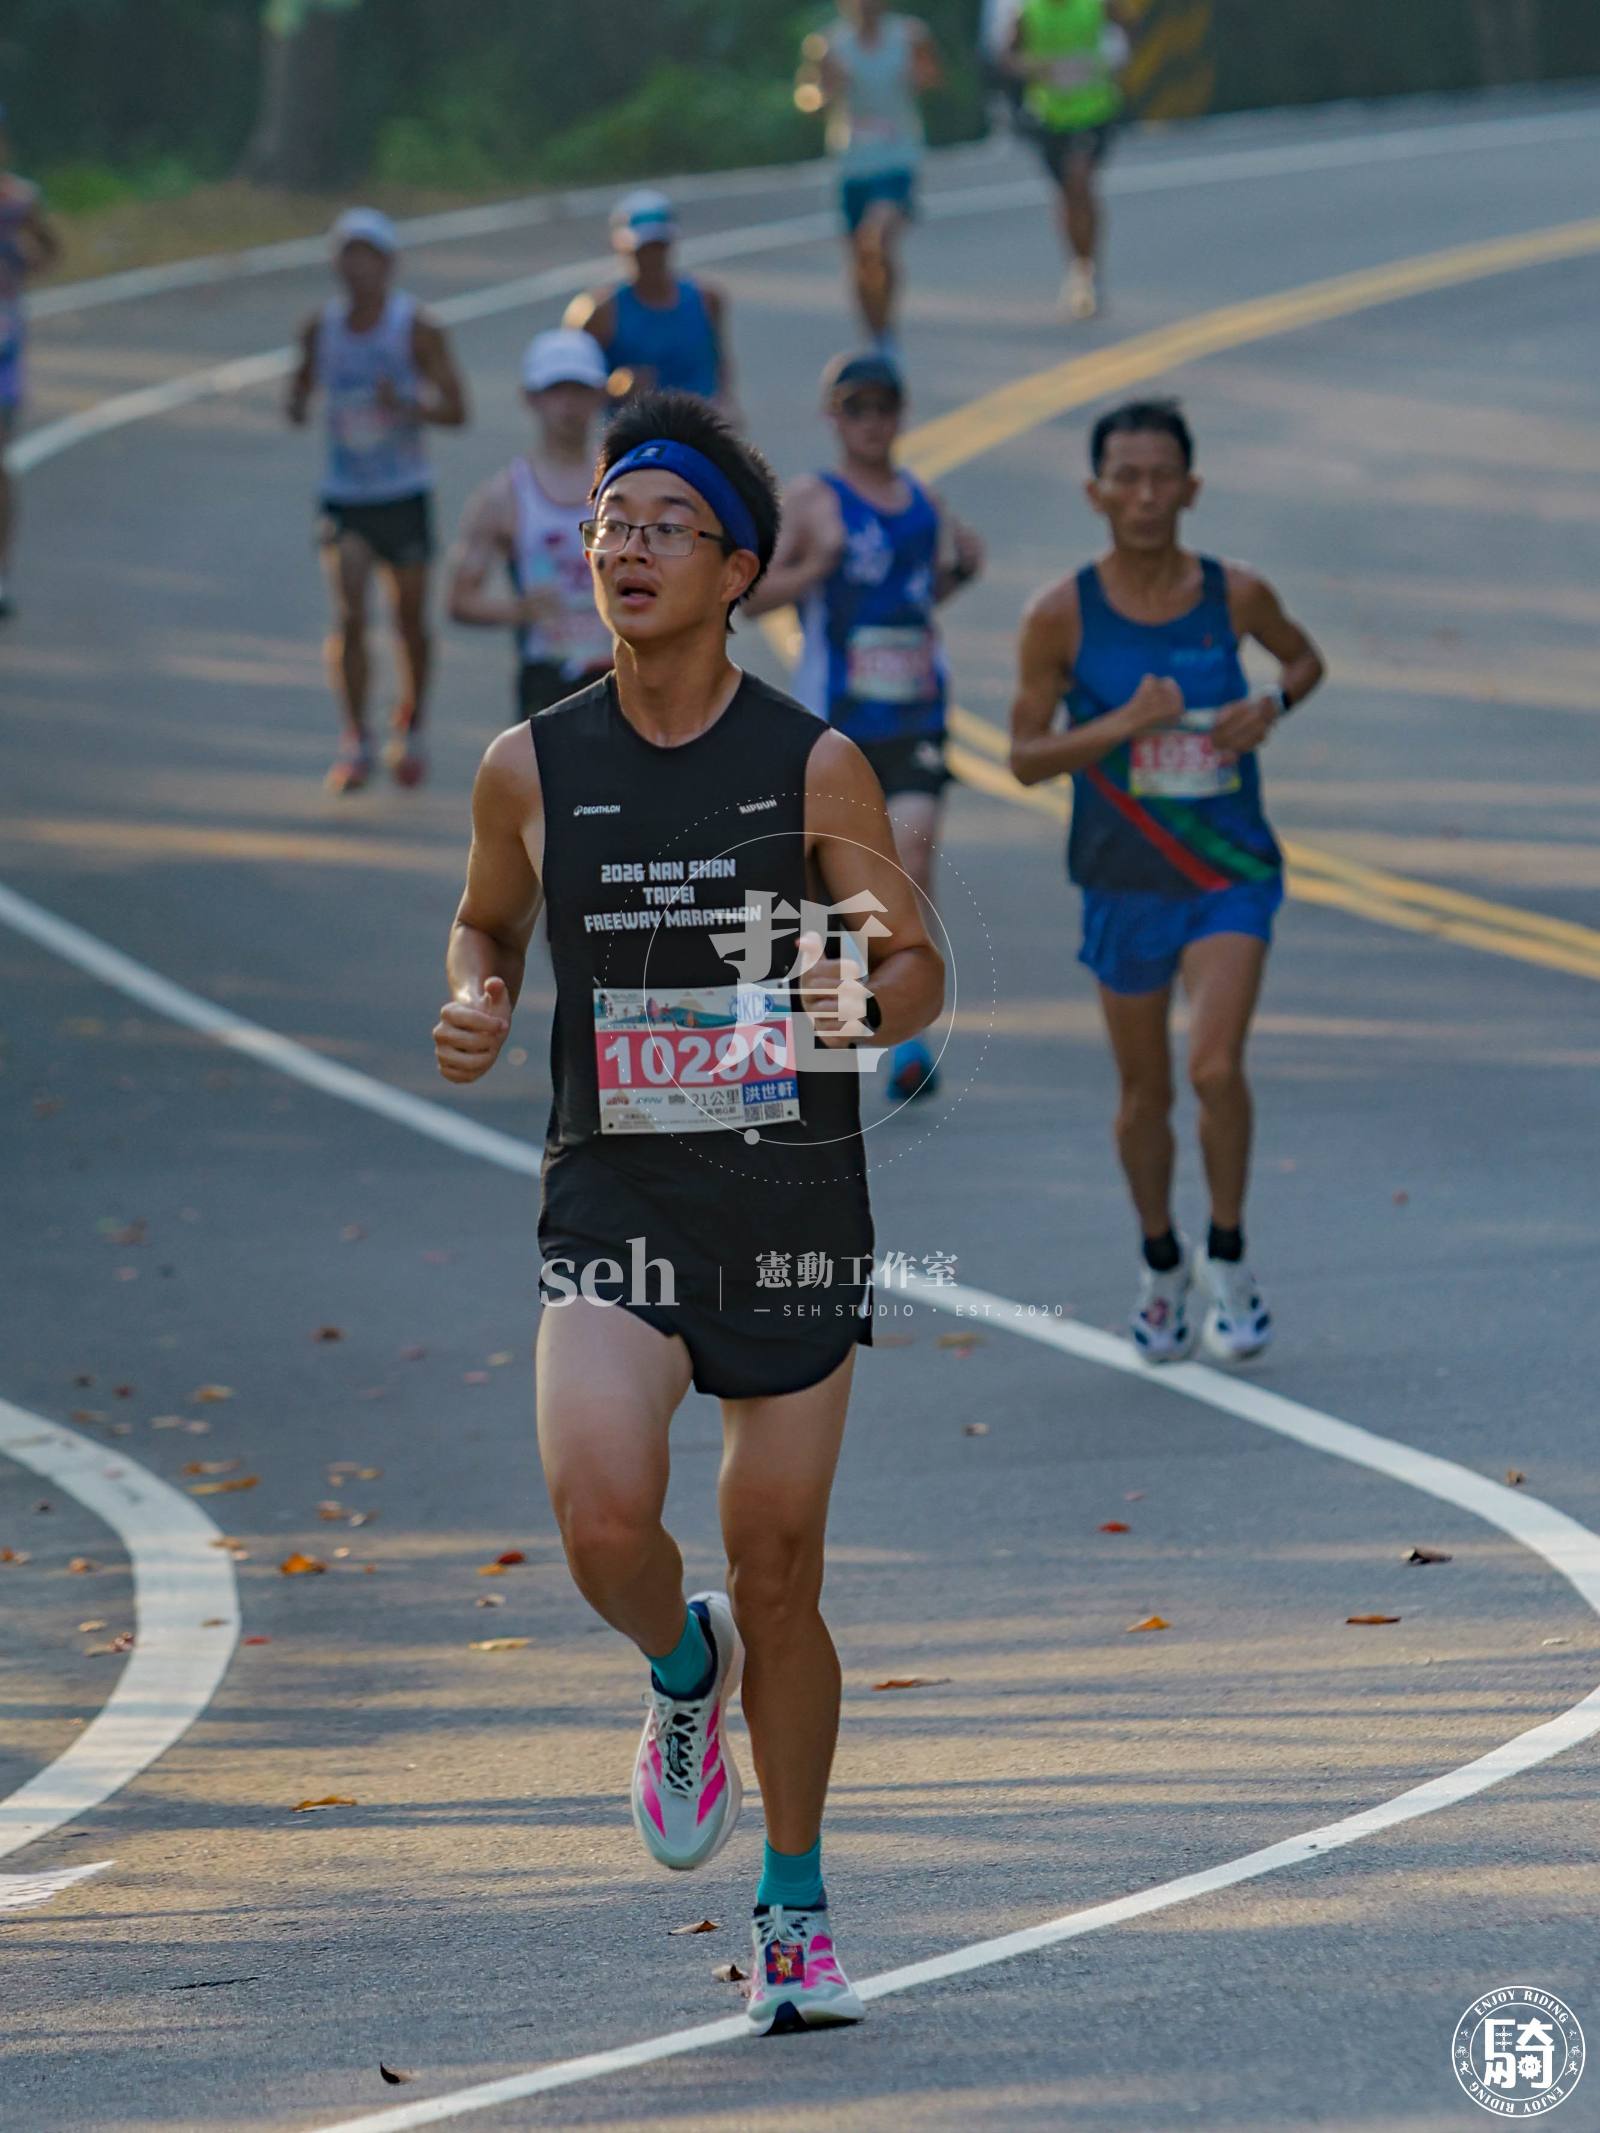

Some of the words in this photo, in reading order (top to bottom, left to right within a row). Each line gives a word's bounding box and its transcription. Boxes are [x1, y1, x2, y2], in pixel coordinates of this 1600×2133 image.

[583, 805, 621, 816] DECATHLON
[601, 863, 644, 883] 2026
[649, 860, 684, 881] NAN
[688, 858, 736, 880] SHAN
[642, 886, 695, 905] TAIPEI
[584, 911, 662, 933] FREEWAY
[665, 905, 762, 928] MARATHON
[605, 1028, 788, 1084] 10290
[692, 1087, 740, 1106] 21公里
[745, 1080, 794, 1101] 洪世軒
